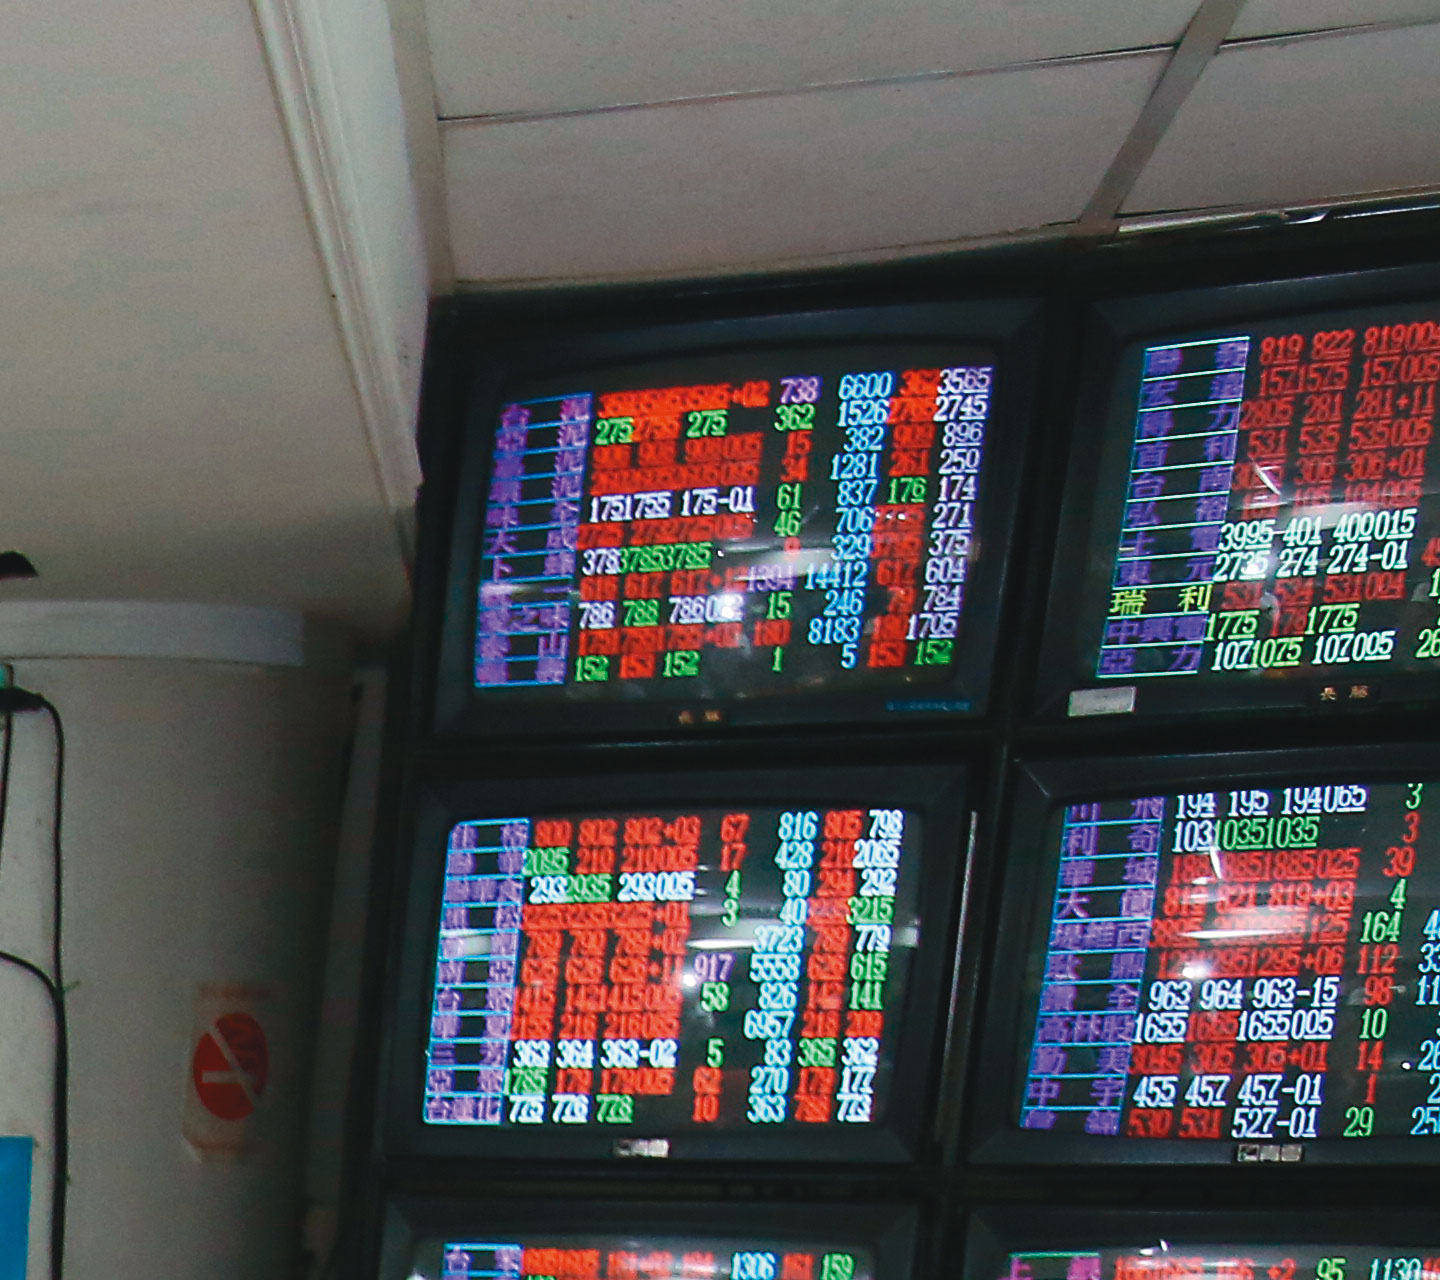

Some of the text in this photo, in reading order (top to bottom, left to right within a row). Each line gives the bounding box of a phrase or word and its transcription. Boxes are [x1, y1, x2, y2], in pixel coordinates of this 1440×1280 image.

[781, 367, 992, 403] 738 6600 3565
[595, 394, 986, 445] 275 275 362 1526 2745
[844, 422, 982, 451] 382 896
[830, 448, 979, 480] 1281 250
[777, 483, 802, 510] 61
[837, 479, 877, 506] 837
[888, 477, 928, 504] 176
[938, 475, 976, 501] 174
[774, 503, 972, 536] 46 706 271
[1219, 517, 1322, 552] 3995 401
[831, 531, 970, 560] 329 375
[805, 558, 966, 590] 14412 604
[1277, 548, 1318, 577] 274
[580, 586, 961, 628] 786 788 15 246 784
[808, 613, 958, 644] 8183 1705
[841, 644, 858, 669] 5
[779, 810, 903, 841] 816 798
[775, 841, 815, 869] 428
[783, 869, 811, 898] 80
[780, 898, 807, 925] 40
[1360, 912, 1402, 943] 164
[750, 952, 800, 982] 5558
[759, 981, 798, 1011] 826
[1149, 982, 1192, 1013] 963
[1200, 980, 1243, 1011] 964
[1360, 1009, 1388, 1040] 10
[765, 1038, 791, 1066] 83
[751, 1066, 790, 1094] 270
[1133, 1075, 1177, 1108] 455
[1185, 1075, 1230, 1107] 457
[1344, 1107, 1373, 1137] 29
